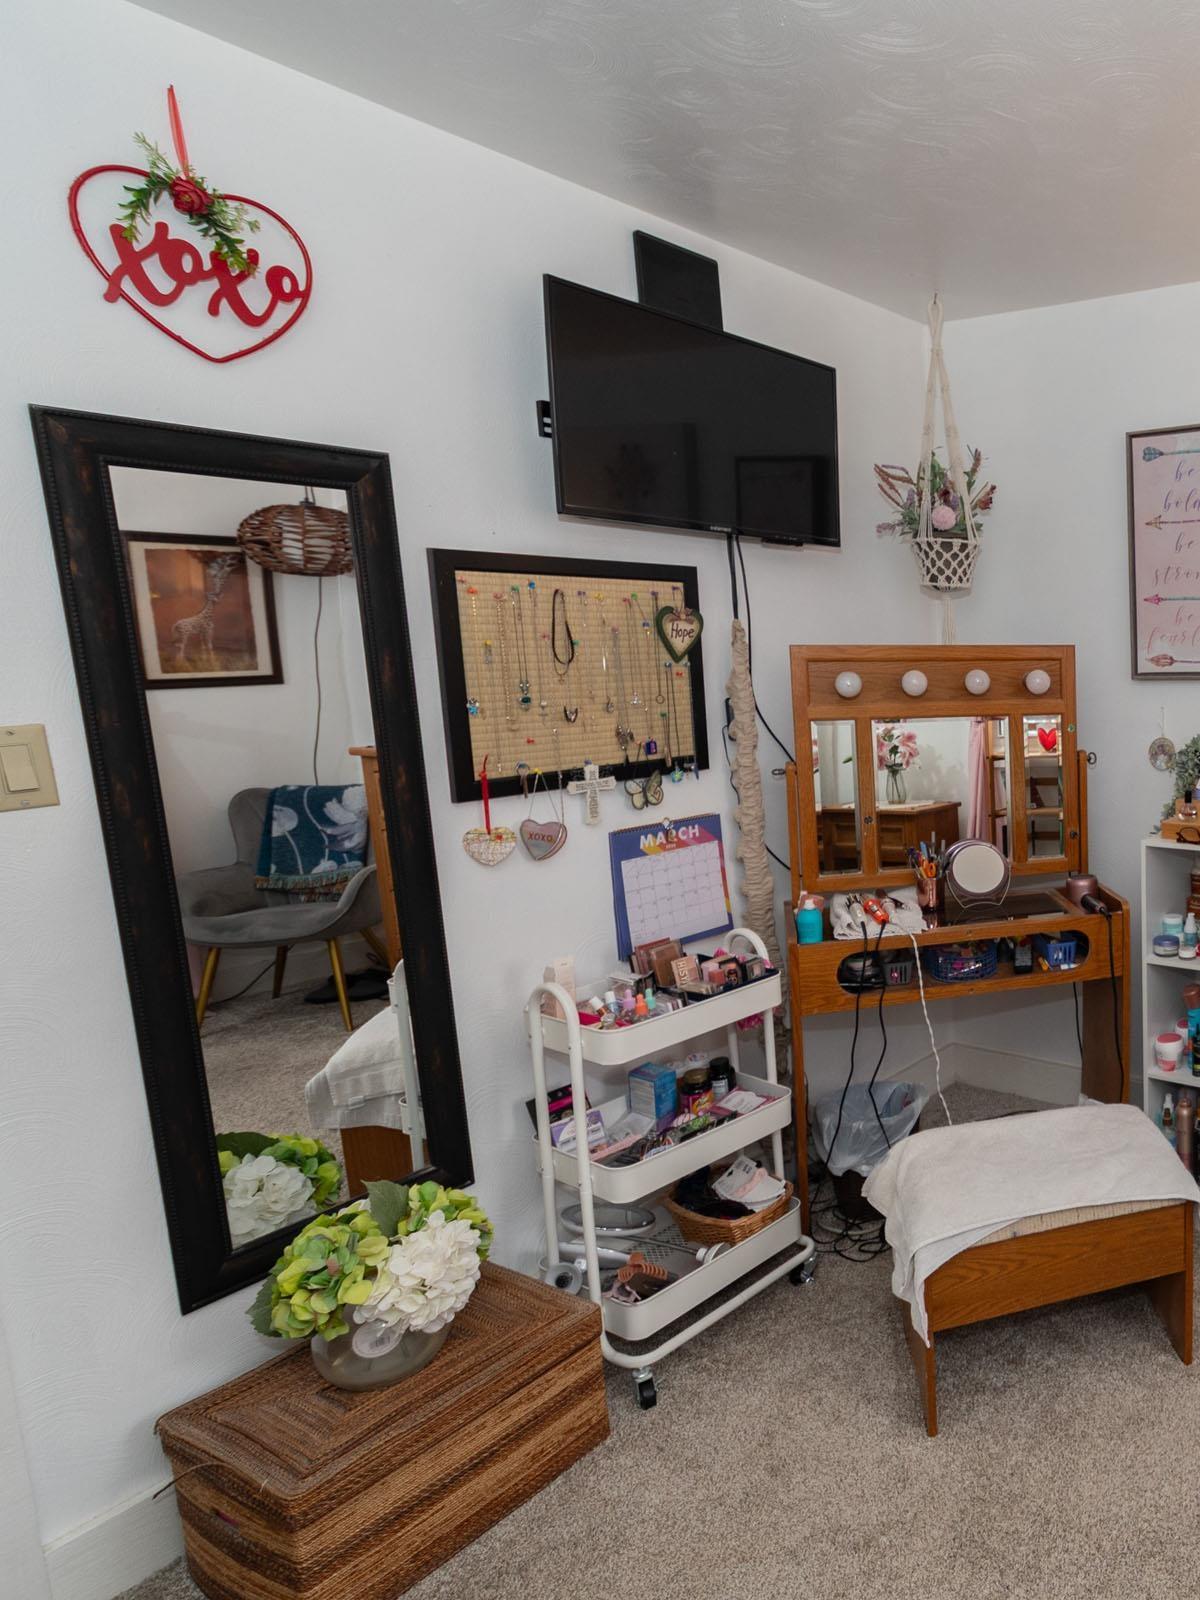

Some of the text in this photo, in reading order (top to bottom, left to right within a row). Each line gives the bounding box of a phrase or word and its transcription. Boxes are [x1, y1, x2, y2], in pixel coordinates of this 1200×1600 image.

[1175, 461, 1196, 481] be
[1175, 533, 1196, 552] be
[1175, 607, 1194, 625] be
[670, 622, 695, 643] Hope
[527, 831, 554, 842] XOXO
